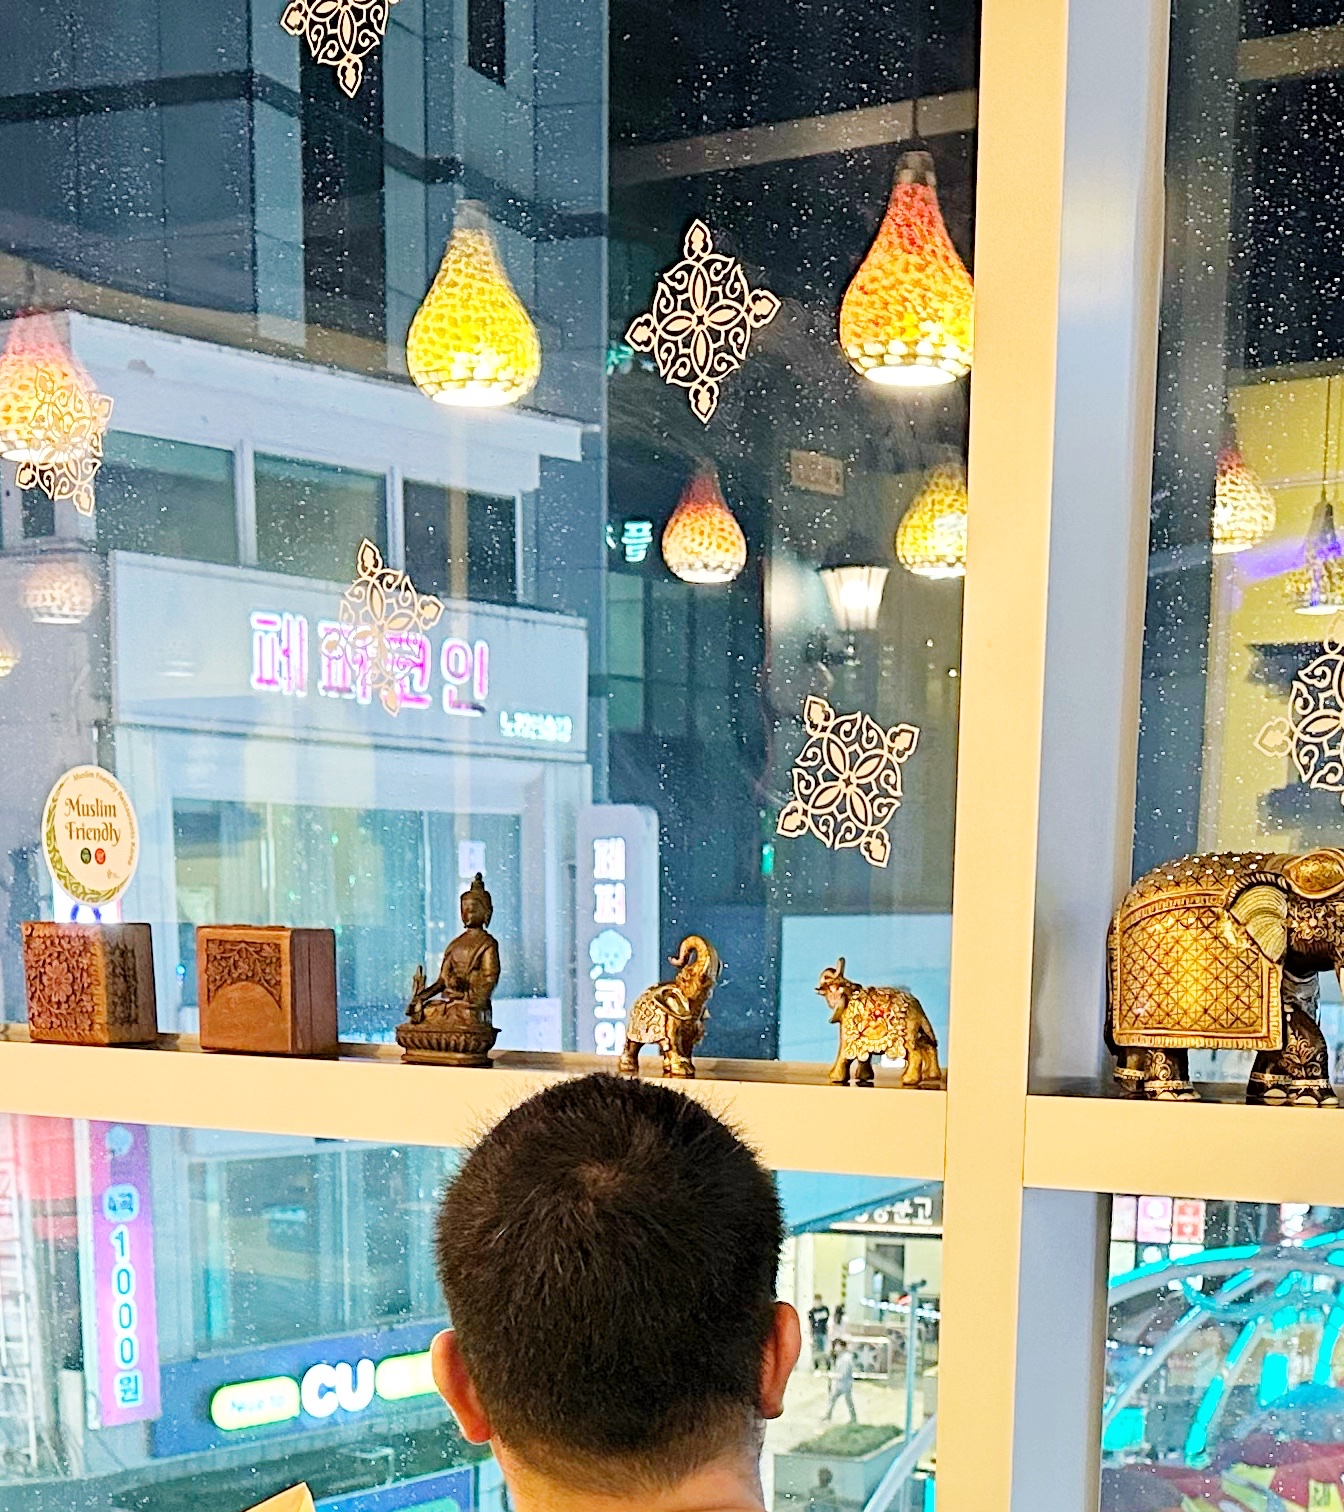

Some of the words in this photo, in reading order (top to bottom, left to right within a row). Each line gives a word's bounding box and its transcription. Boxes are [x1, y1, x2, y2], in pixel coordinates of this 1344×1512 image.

[64, 794, 117, 818] Muslim
[65, 822, 121, 847] Friendly
[301, 1358, 375, 1418] CU
